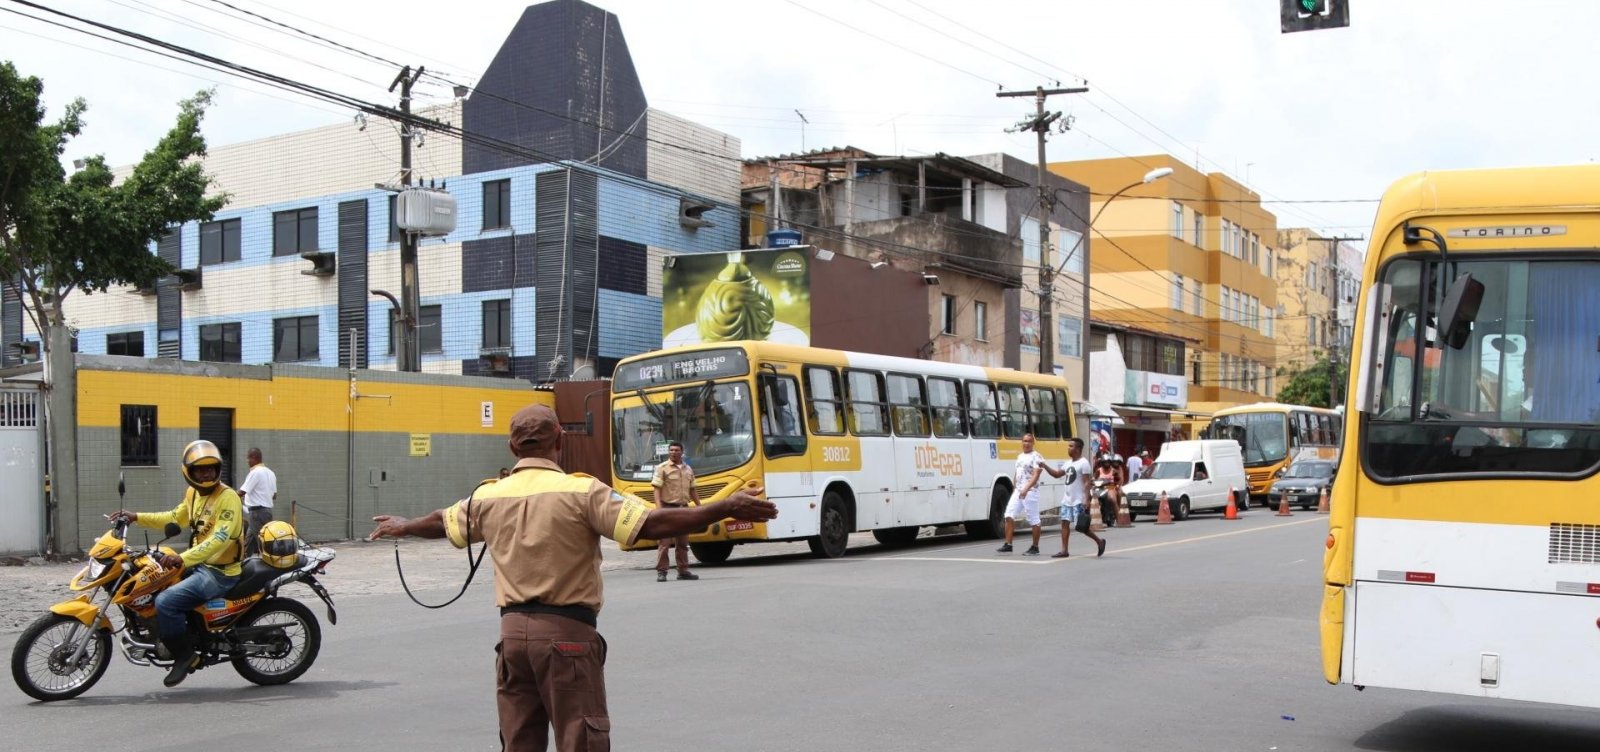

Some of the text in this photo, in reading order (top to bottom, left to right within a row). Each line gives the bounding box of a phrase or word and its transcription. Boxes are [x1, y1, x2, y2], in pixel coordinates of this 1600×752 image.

[1462, 226, 1551, 237] TORINO
[674, 356, 726, 370] ENG VELHO
[682, 364, 718, 375] BROTAS
[639, 364, 663, 380] 0234
[484, 405, 490, 418] E
[822, 446, 851, 462] 30812
